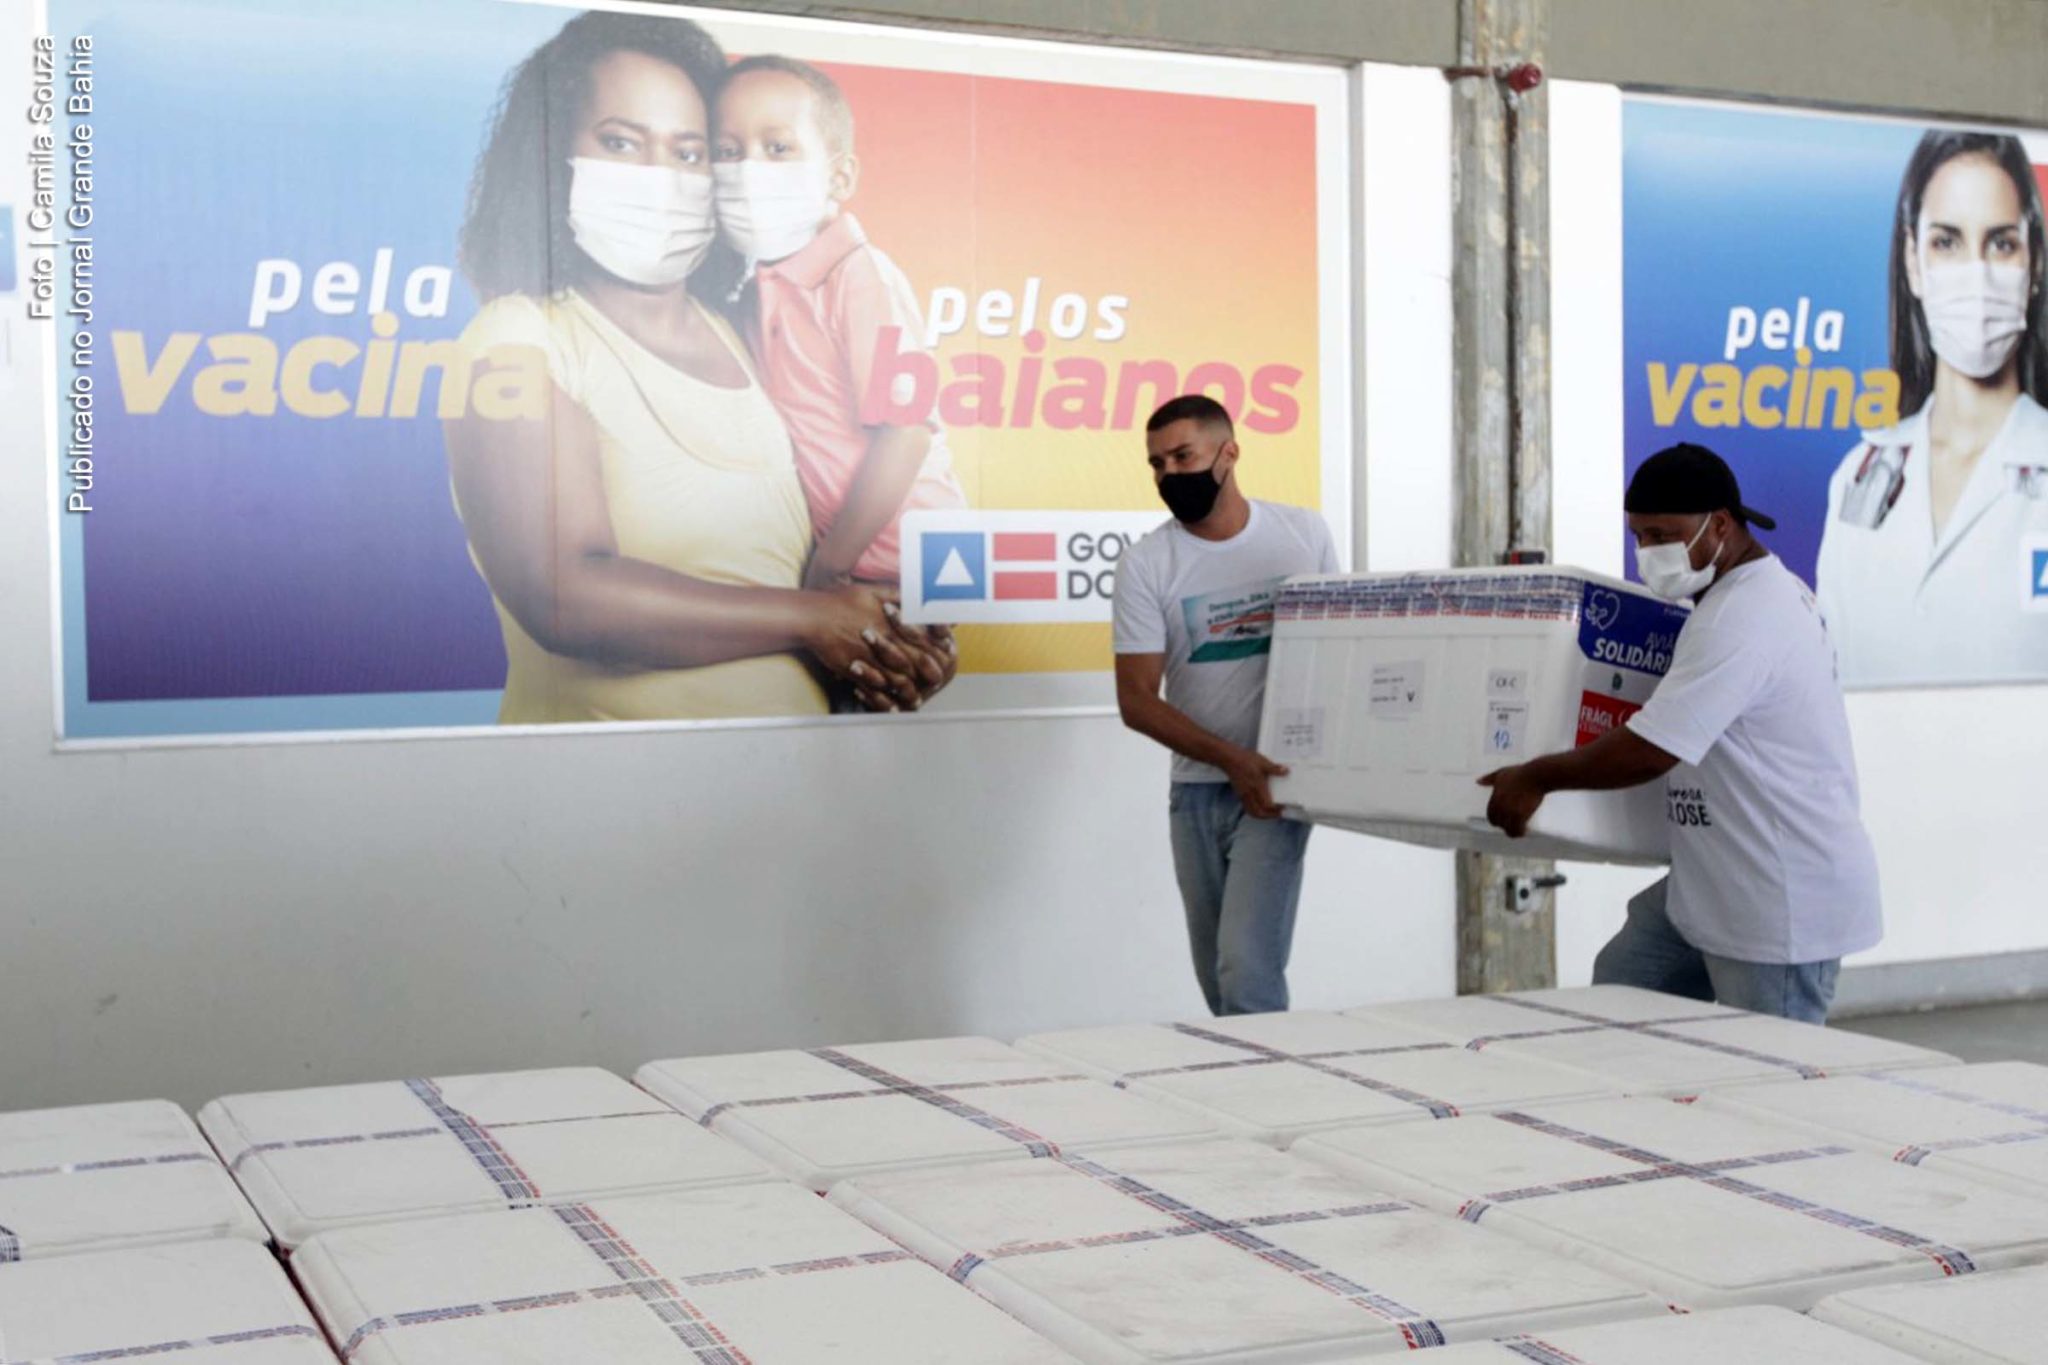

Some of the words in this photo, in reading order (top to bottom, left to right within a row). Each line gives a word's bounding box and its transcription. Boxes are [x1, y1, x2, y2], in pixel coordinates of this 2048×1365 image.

[248, 248, 453, 328] pela
[925, 277, 1130, 349] pelos
[1725, 297, 1845, 361] pela
[110, 310, 547, 419] vacina
[860, 325, 1304, 435] baianos
[1645, 346, 1902, 431] vacina
